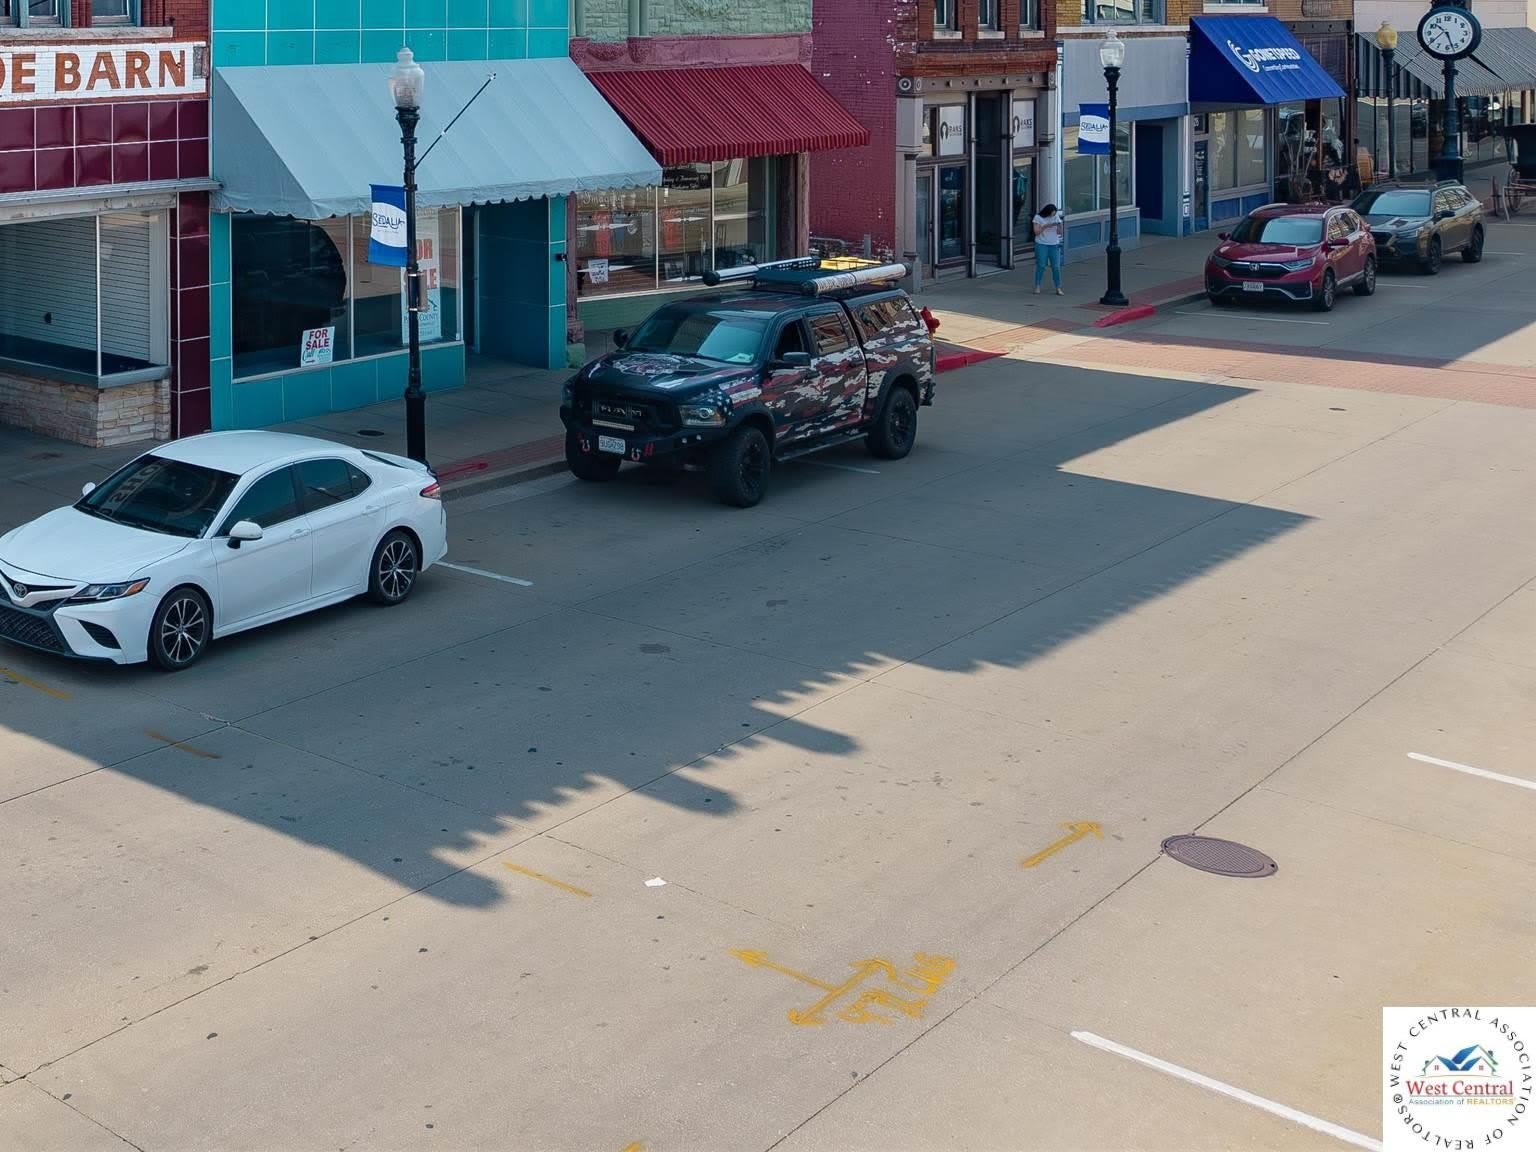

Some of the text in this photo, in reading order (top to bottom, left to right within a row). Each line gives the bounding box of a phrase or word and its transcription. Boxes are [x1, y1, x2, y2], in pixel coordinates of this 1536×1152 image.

[54, 50, 185, 91] BARN
[372, 213, 405, 229] SEDALIA
[309, 329, 328, 340] FOR
[306, 338, 330, 350] SALE
